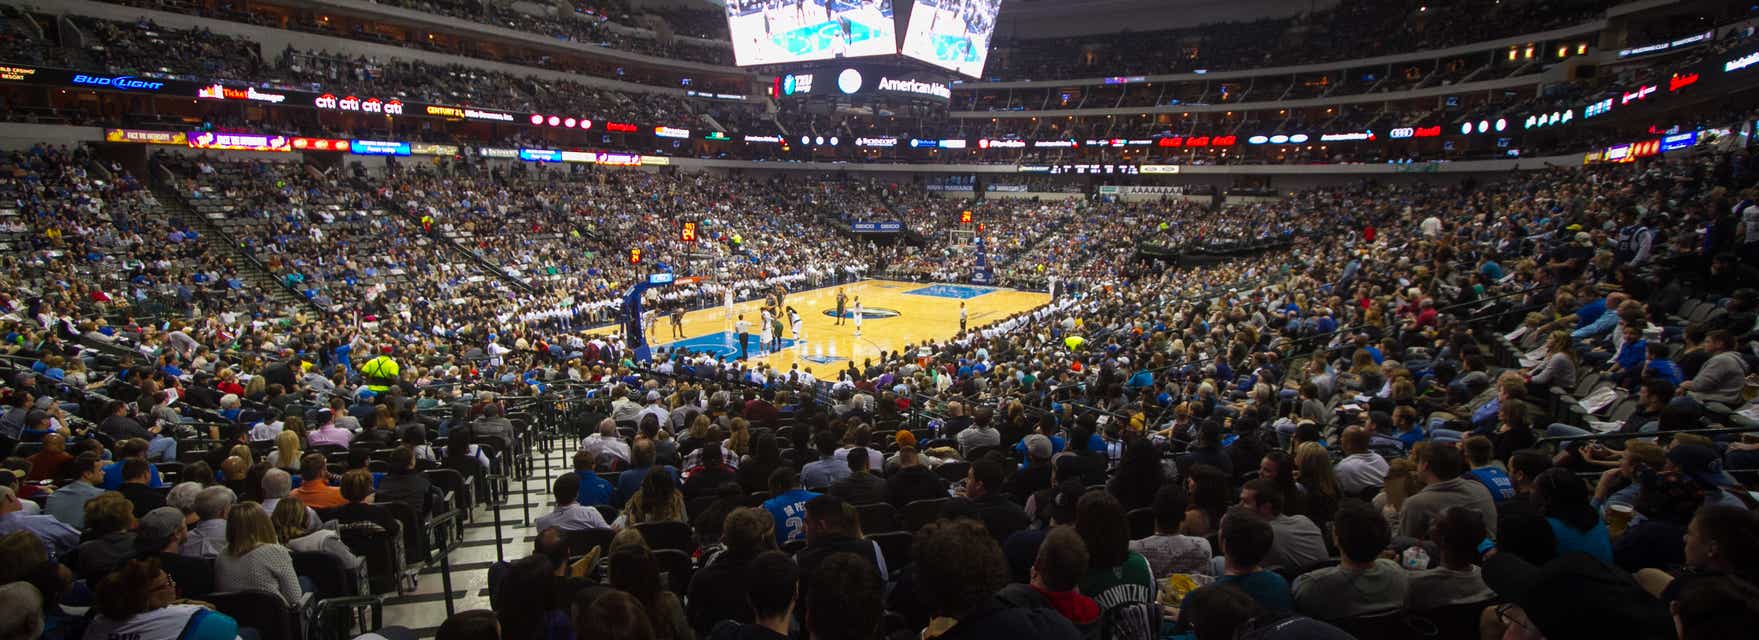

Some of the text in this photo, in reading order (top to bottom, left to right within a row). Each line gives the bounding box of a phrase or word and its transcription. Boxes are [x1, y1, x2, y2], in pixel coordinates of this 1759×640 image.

[73, 75, 164, 89] BUD LIGHT
[878, 77, 931, 94] American
[315, 97, 404, 114] citi citi citi citi
[426, 106, 454, 115] CENTURY
[1414, 126, 1440, 137] Audi
[682, 229, 695, 240] 24
